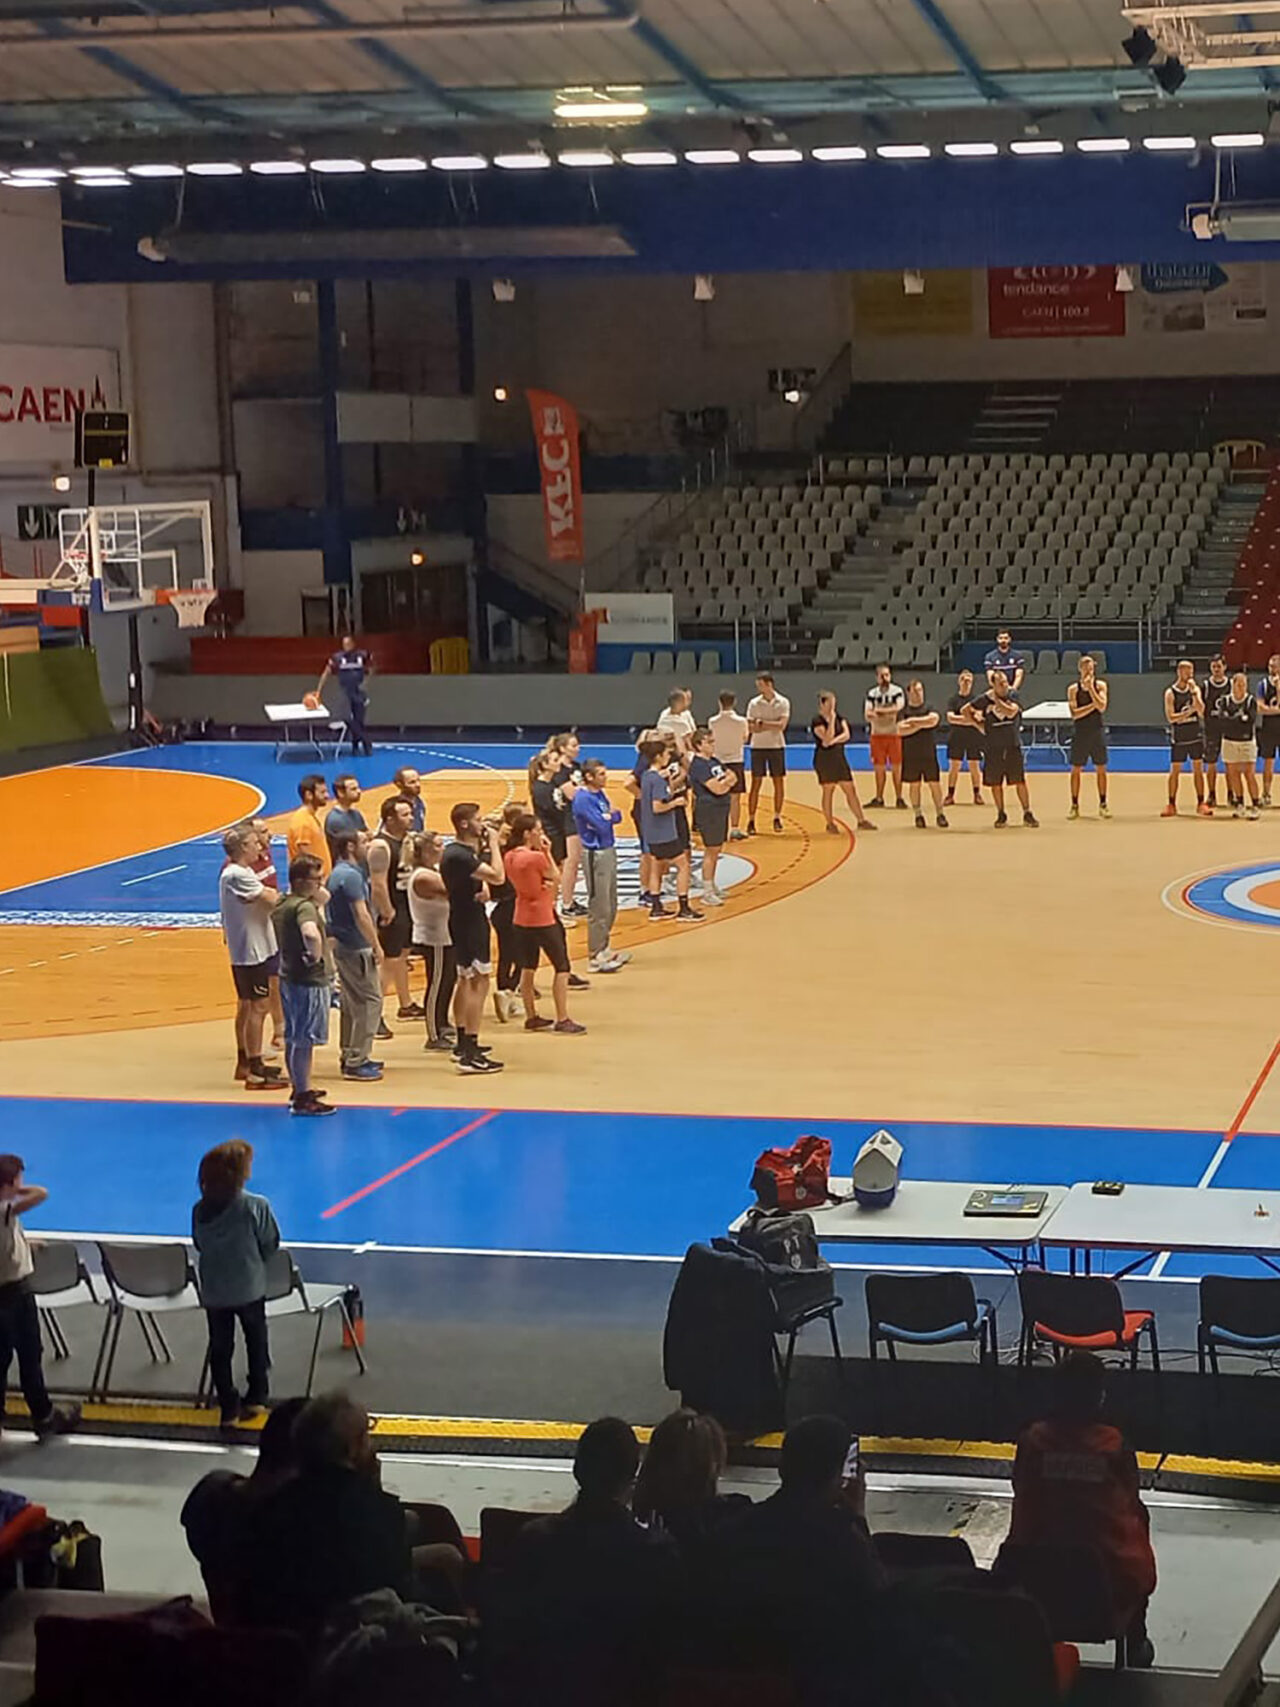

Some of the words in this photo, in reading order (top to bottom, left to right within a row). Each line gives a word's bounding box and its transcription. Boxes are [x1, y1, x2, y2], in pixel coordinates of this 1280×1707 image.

[1003, 282, 1069, 296] tendance
[0, 385, 85, 424] CAEN
[542, 438, 575, 537] KFC
